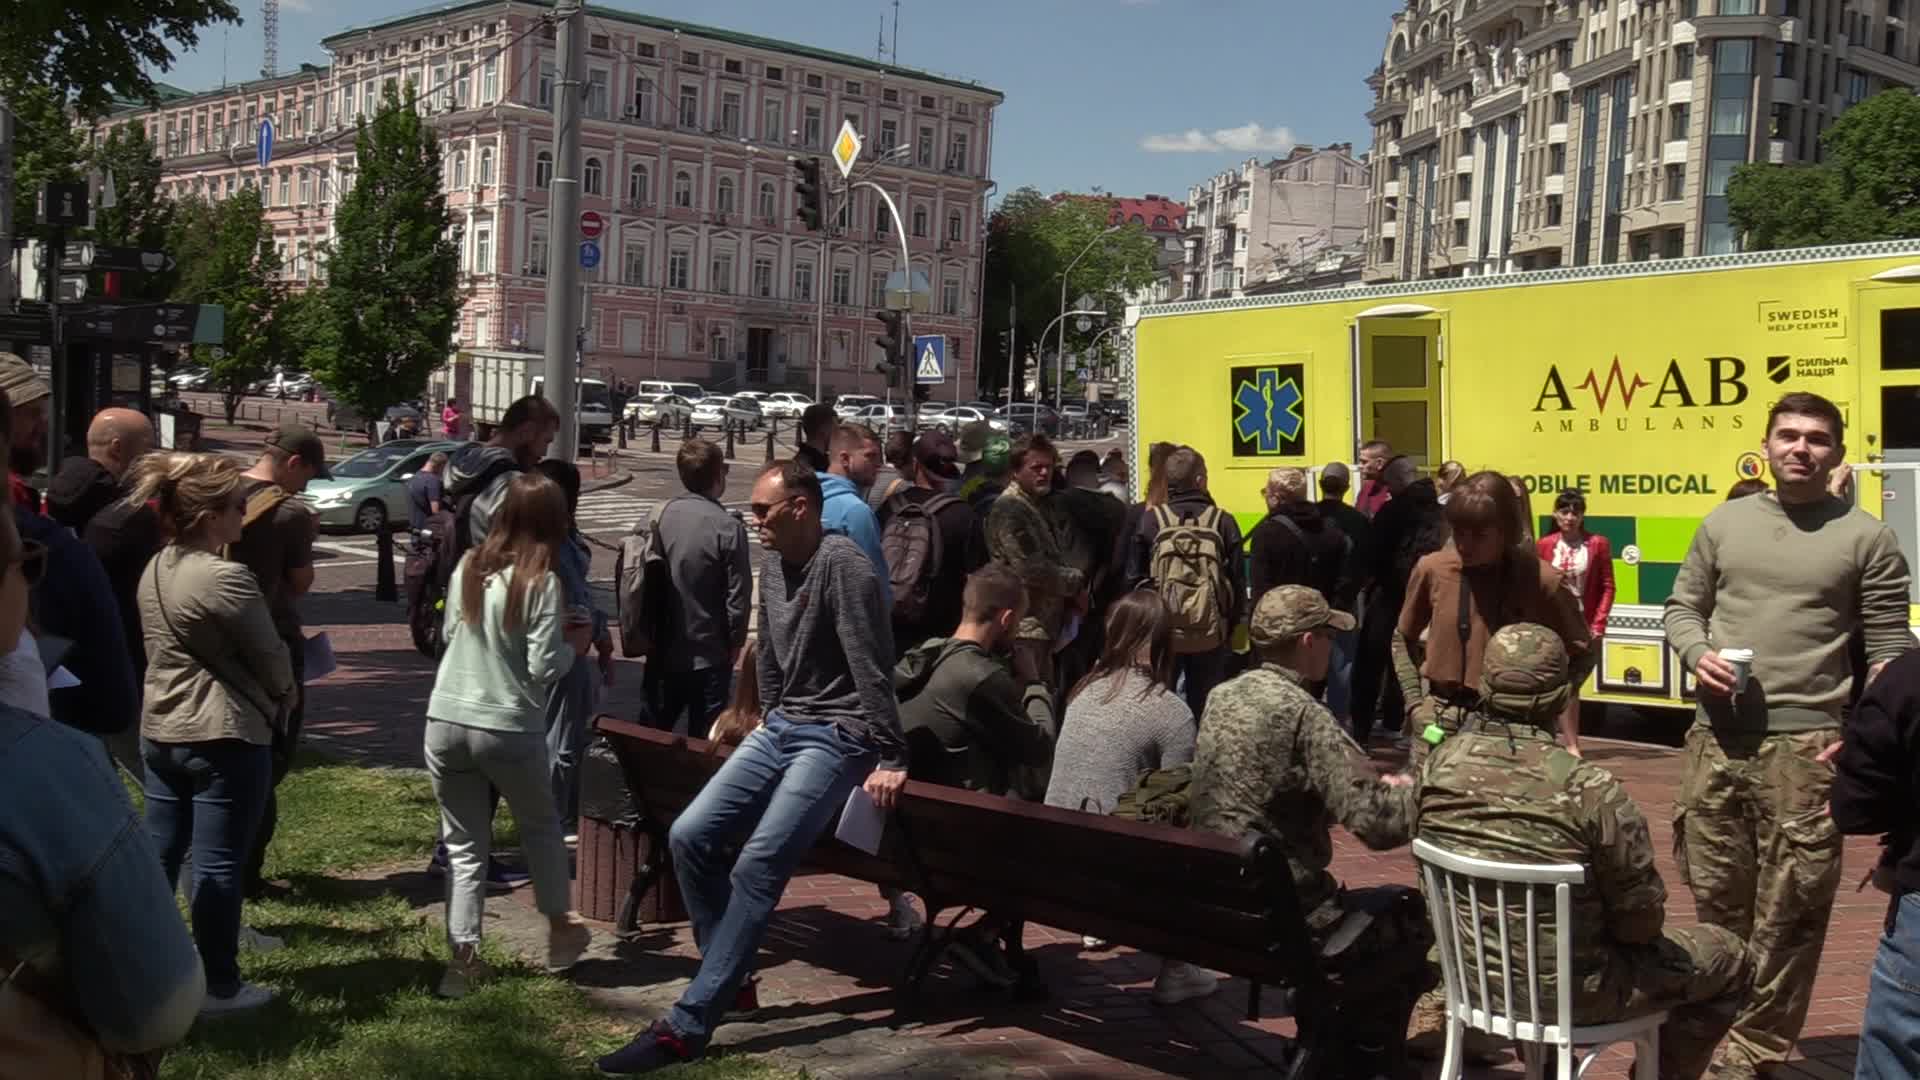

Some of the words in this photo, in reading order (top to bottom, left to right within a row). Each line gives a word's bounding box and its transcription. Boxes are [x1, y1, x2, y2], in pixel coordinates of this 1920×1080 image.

[1768, 308, 1839, 322] SWEDISH
[1768, 323, 1795, 332] HELP
[1796, 321, 1839, 331] CENTER
[1796, 357, 1849, 368] СИЛЬНА
[1796, 367, 1835, 378] НАЦІЯ
[1532, 414, 1744, 433] AMBULANS
[1522, 474, 1592, 495] OBILE
[1599, 474, 1716, 495] MEDICAL
